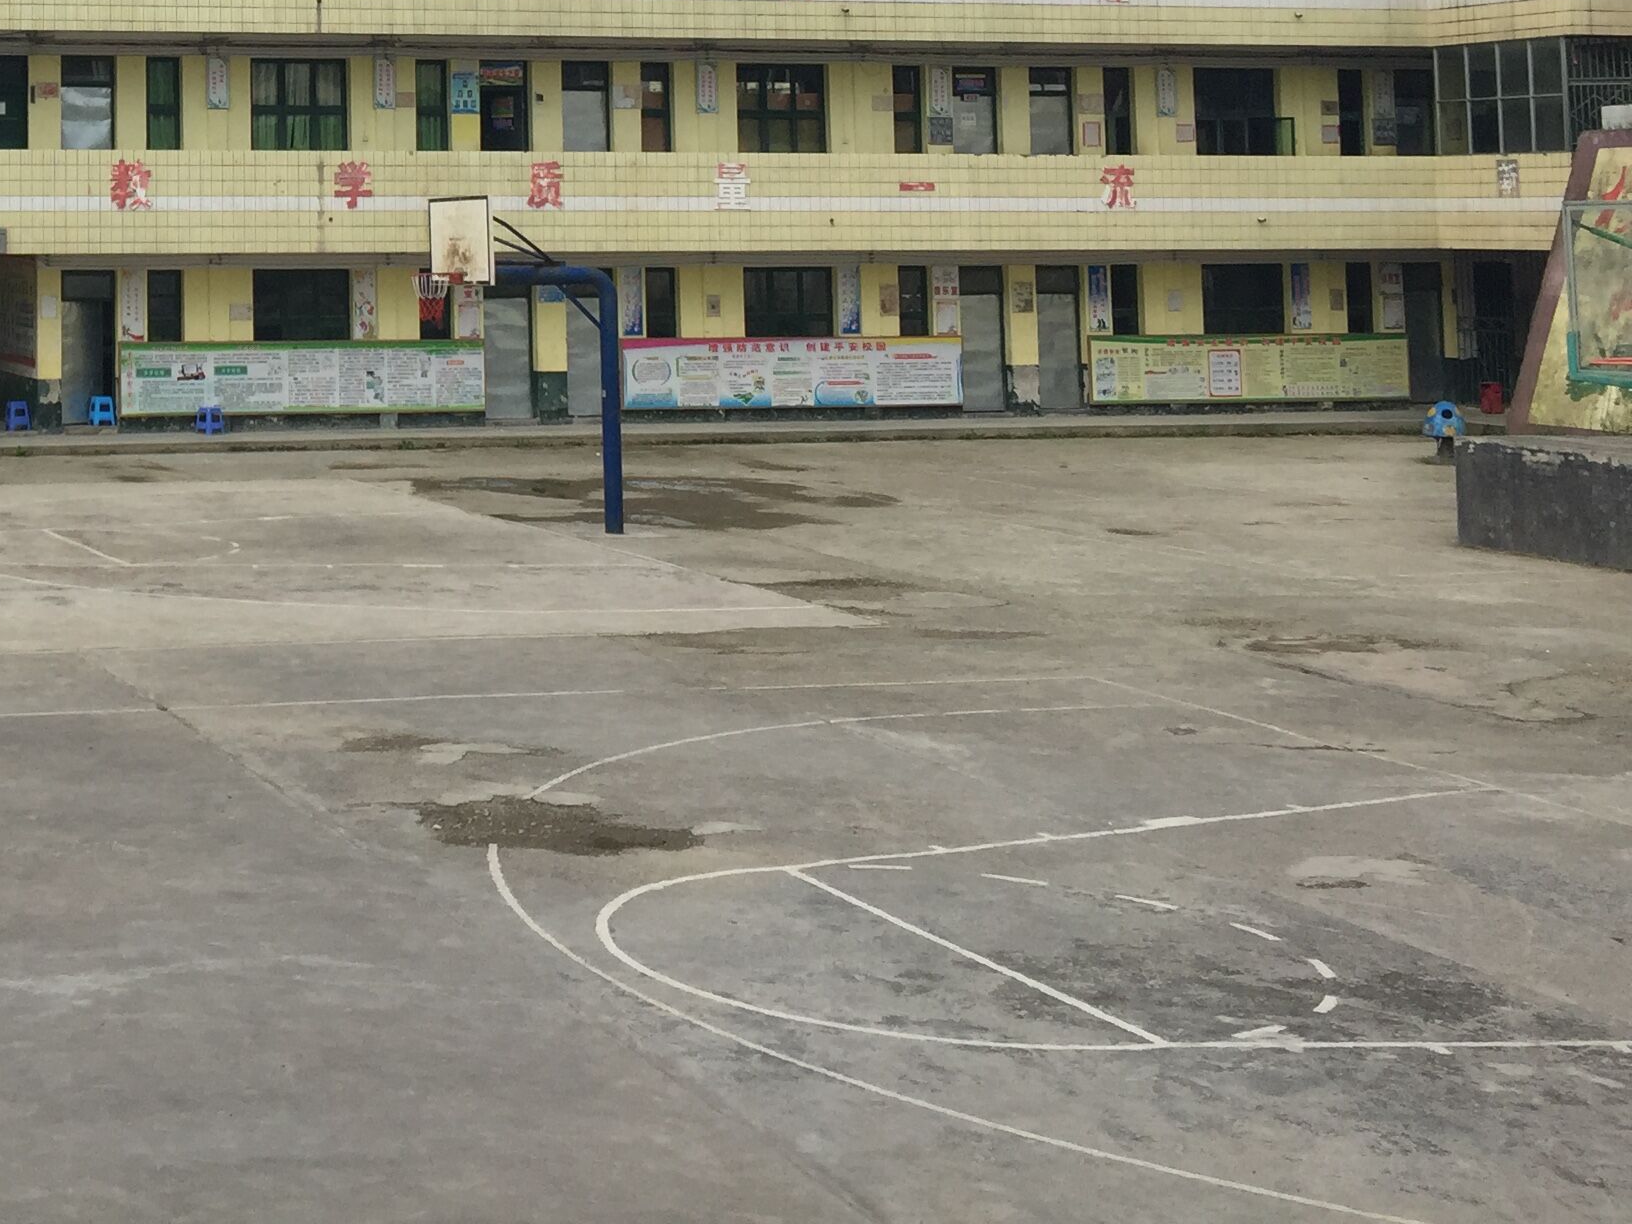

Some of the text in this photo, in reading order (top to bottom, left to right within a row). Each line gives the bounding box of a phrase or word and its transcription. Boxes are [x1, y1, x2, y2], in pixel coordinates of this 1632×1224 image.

[109, 158, 1137, 211] 教学质量一流
[806, 341, 886, 352] 创建平安校园
